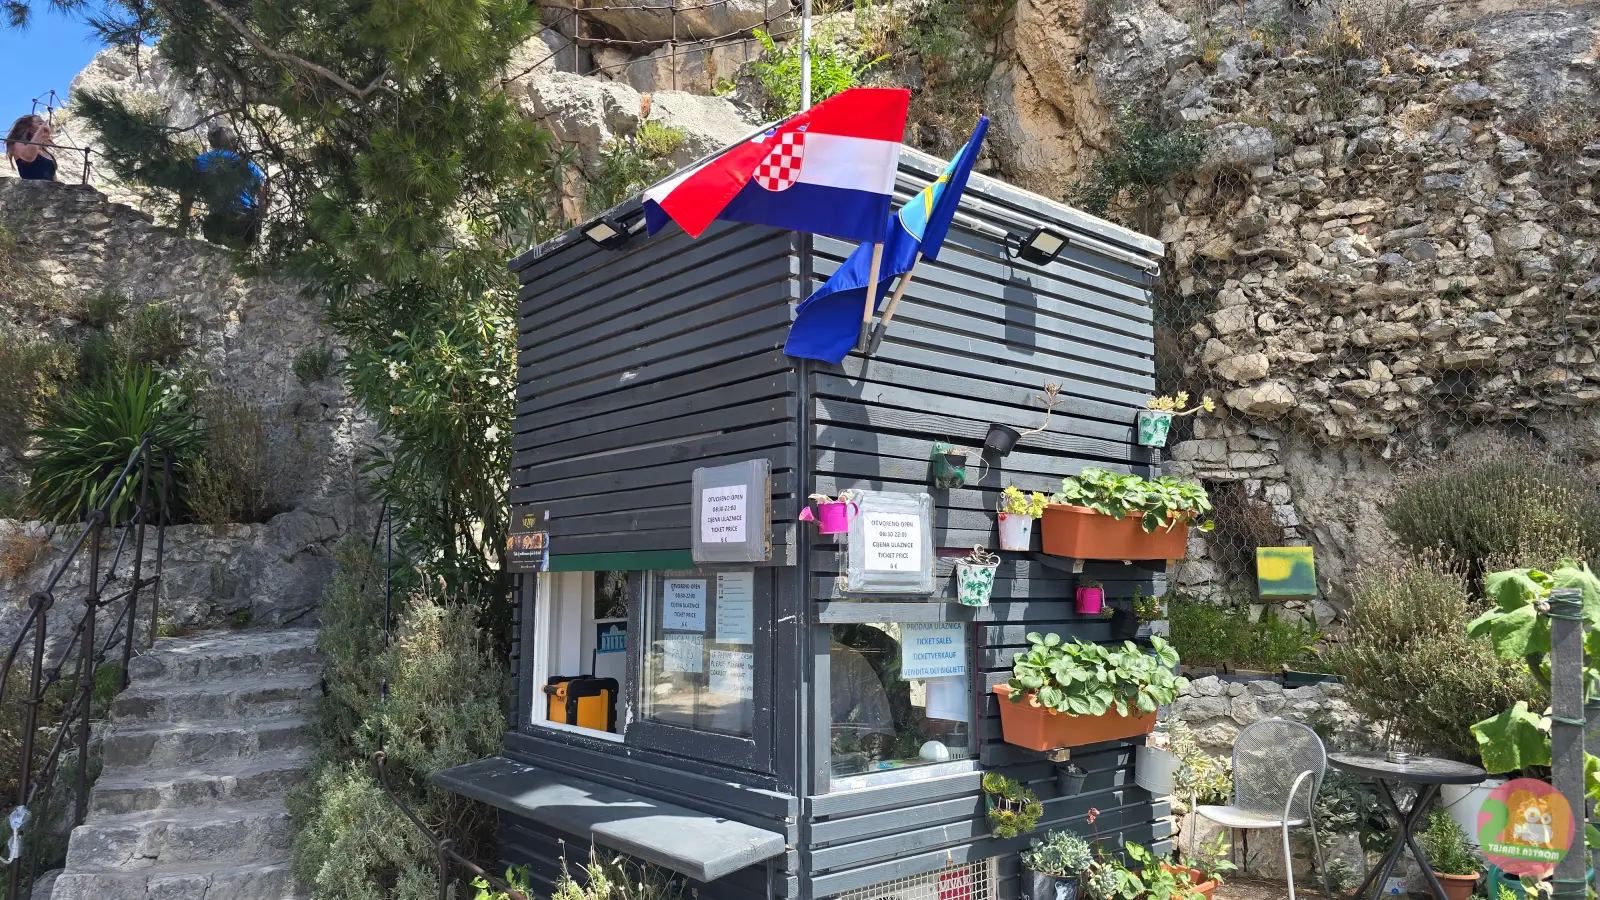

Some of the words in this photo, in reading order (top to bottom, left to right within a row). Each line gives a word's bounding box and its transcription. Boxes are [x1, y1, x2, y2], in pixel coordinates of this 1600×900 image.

[917, 637, 935, 645] TICKET
[936, 637, 952, 645] SALES
[913, 652, 956, 660] TICKETVERKAUF
[904, 667, 929, 676] VENDITA
[941, 666, 965, 674] BIGLIETTI
